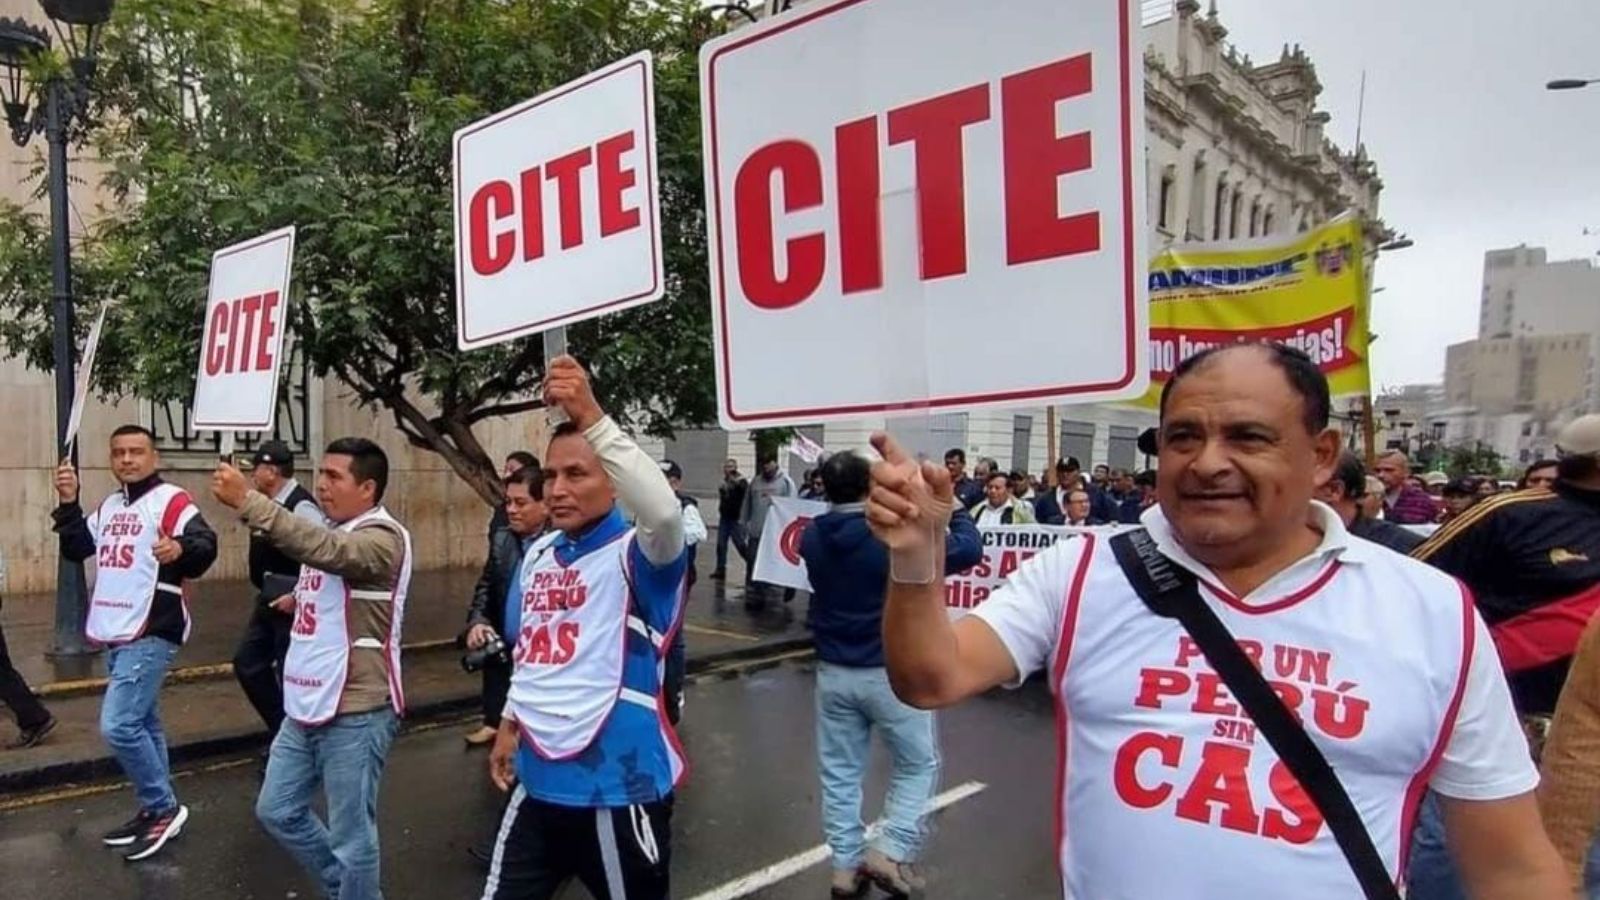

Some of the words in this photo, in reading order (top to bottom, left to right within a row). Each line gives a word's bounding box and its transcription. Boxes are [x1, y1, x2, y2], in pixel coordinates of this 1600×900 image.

[469, 130, 640, 276] CITE
[734, 52, 1100, 309] CITE
[206, 290, 279, 377] CITE
[1175, 636, 1263, 674] PR
[1274, 644, 1331, 686] UN
[1213, 719, 1256, 745] SIN
[1113, 732, 1325, 845] CAS
